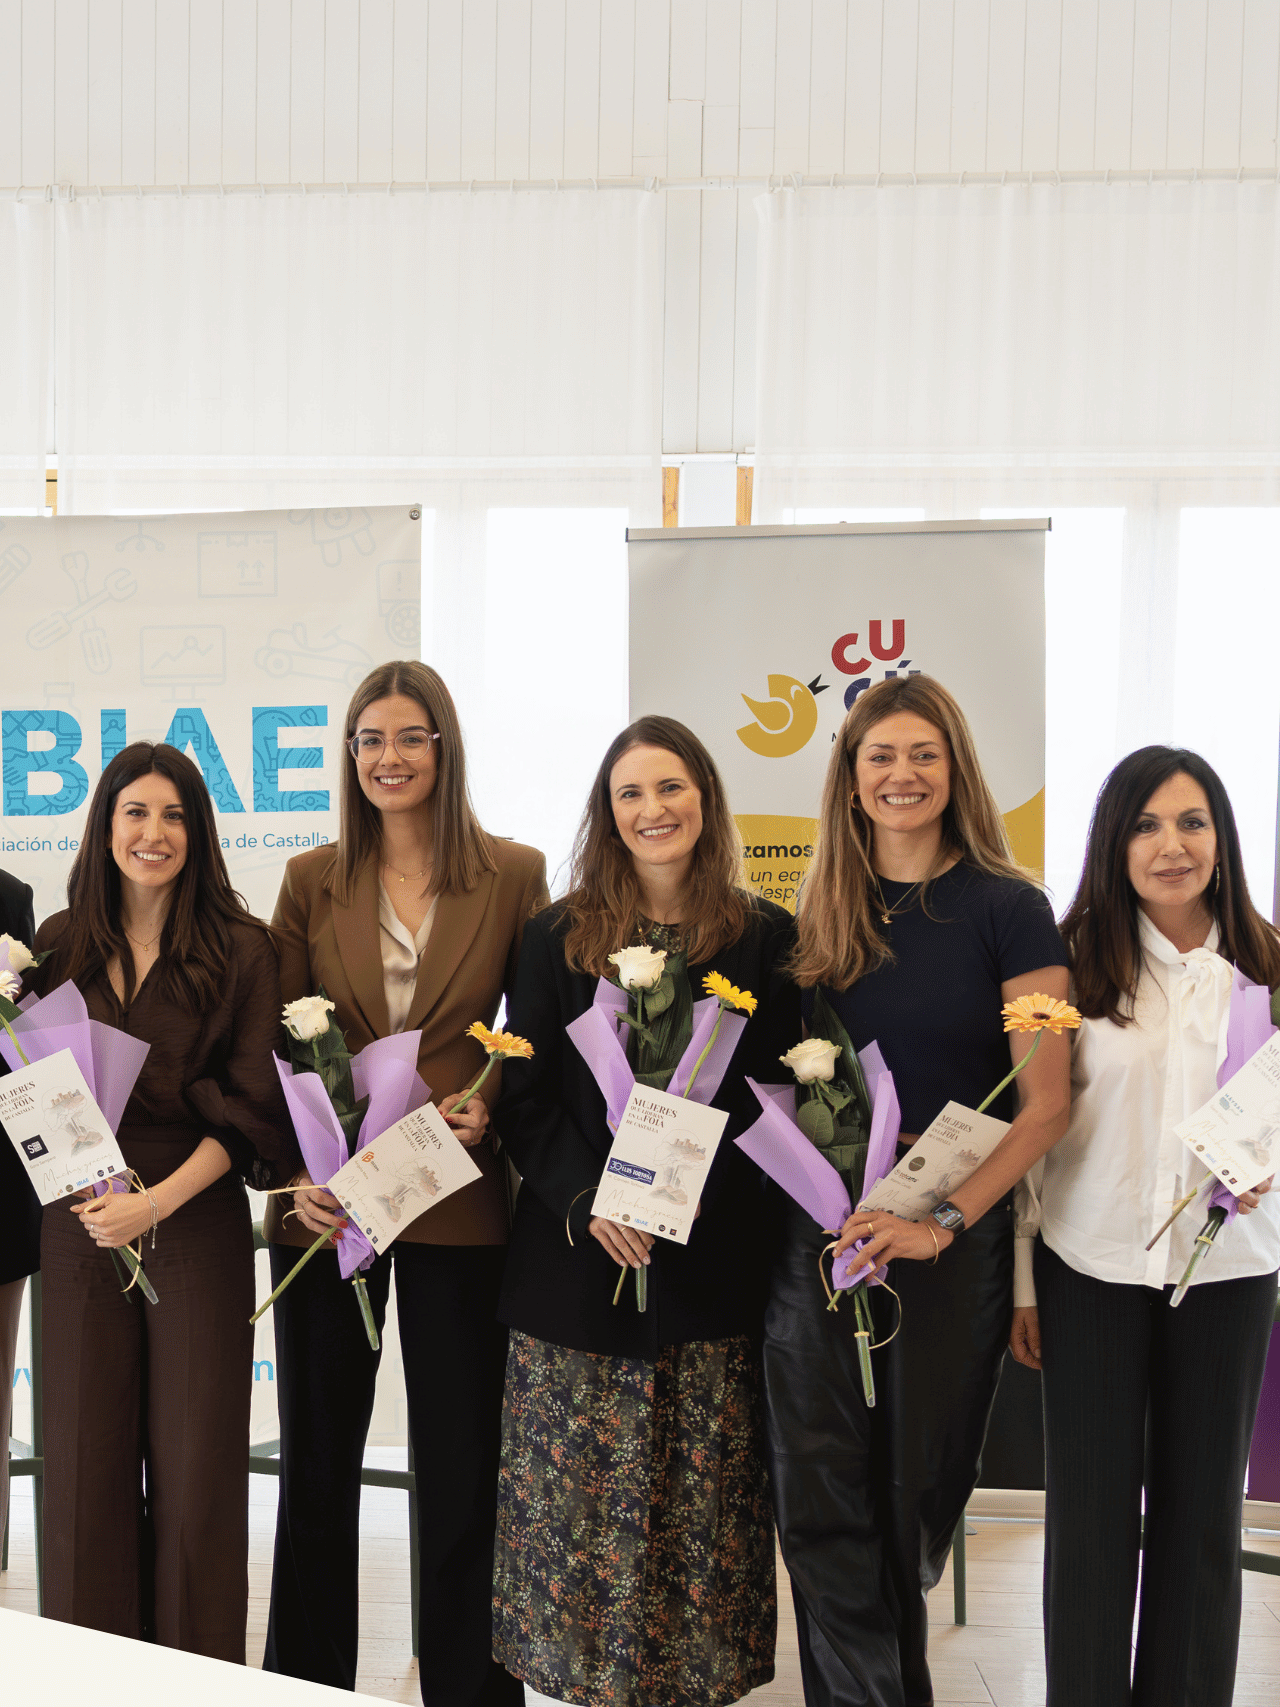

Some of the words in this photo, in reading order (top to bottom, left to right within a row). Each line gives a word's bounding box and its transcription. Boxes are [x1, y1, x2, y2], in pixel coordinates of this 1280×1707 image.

[831, 619, 905, 675] CU
[57, 836, 79, 851] de
[236, 833, 258, 848] de
[263, 832, 329, 848] Castalla
[743, 845, 814, 858] zamos
[750, 871, 772, 882] un
[778, 870, 805, 885] eq
[13, 1095, 34, 1109] FOIA
[632, 1097, 678, 1118] MUJERES
[642, 1115, 665, 1128] FOIA
[414, 1112, 443, 1150] MUJERES
[411, 1130, 427, 1150] FOIA
